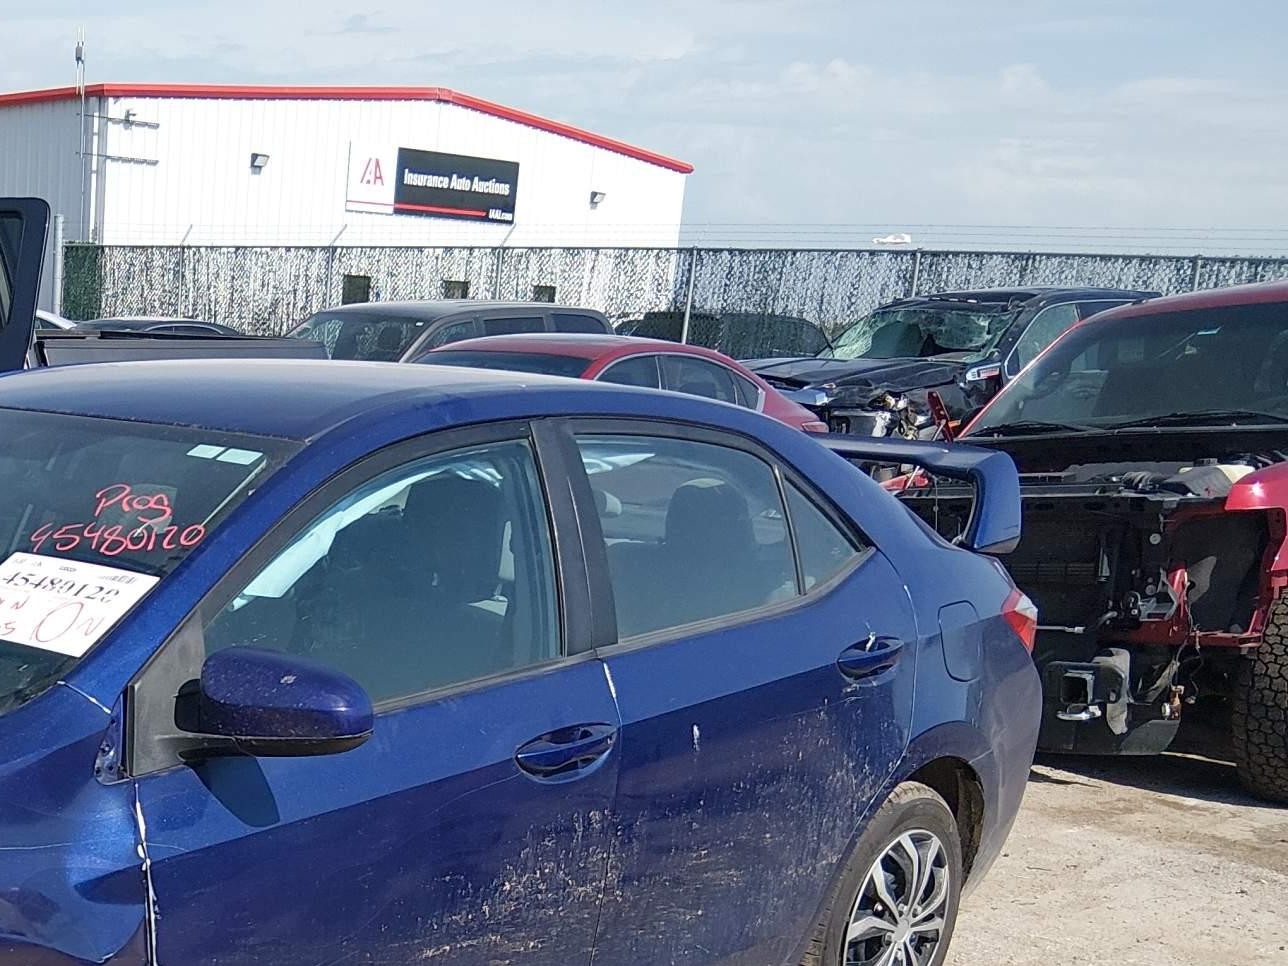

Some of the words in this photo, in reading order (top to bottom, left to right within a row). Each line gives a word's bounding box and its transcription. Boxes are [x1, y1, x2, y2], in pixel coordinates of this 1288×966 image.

[403, 168, 450, 189] Insurance
[450, 173, 471, 191] Auto
[471, 176, 511, 195] Auctions
[95, 483, 172, 525] Prog
[2, 571, 120, 603] 45480120
